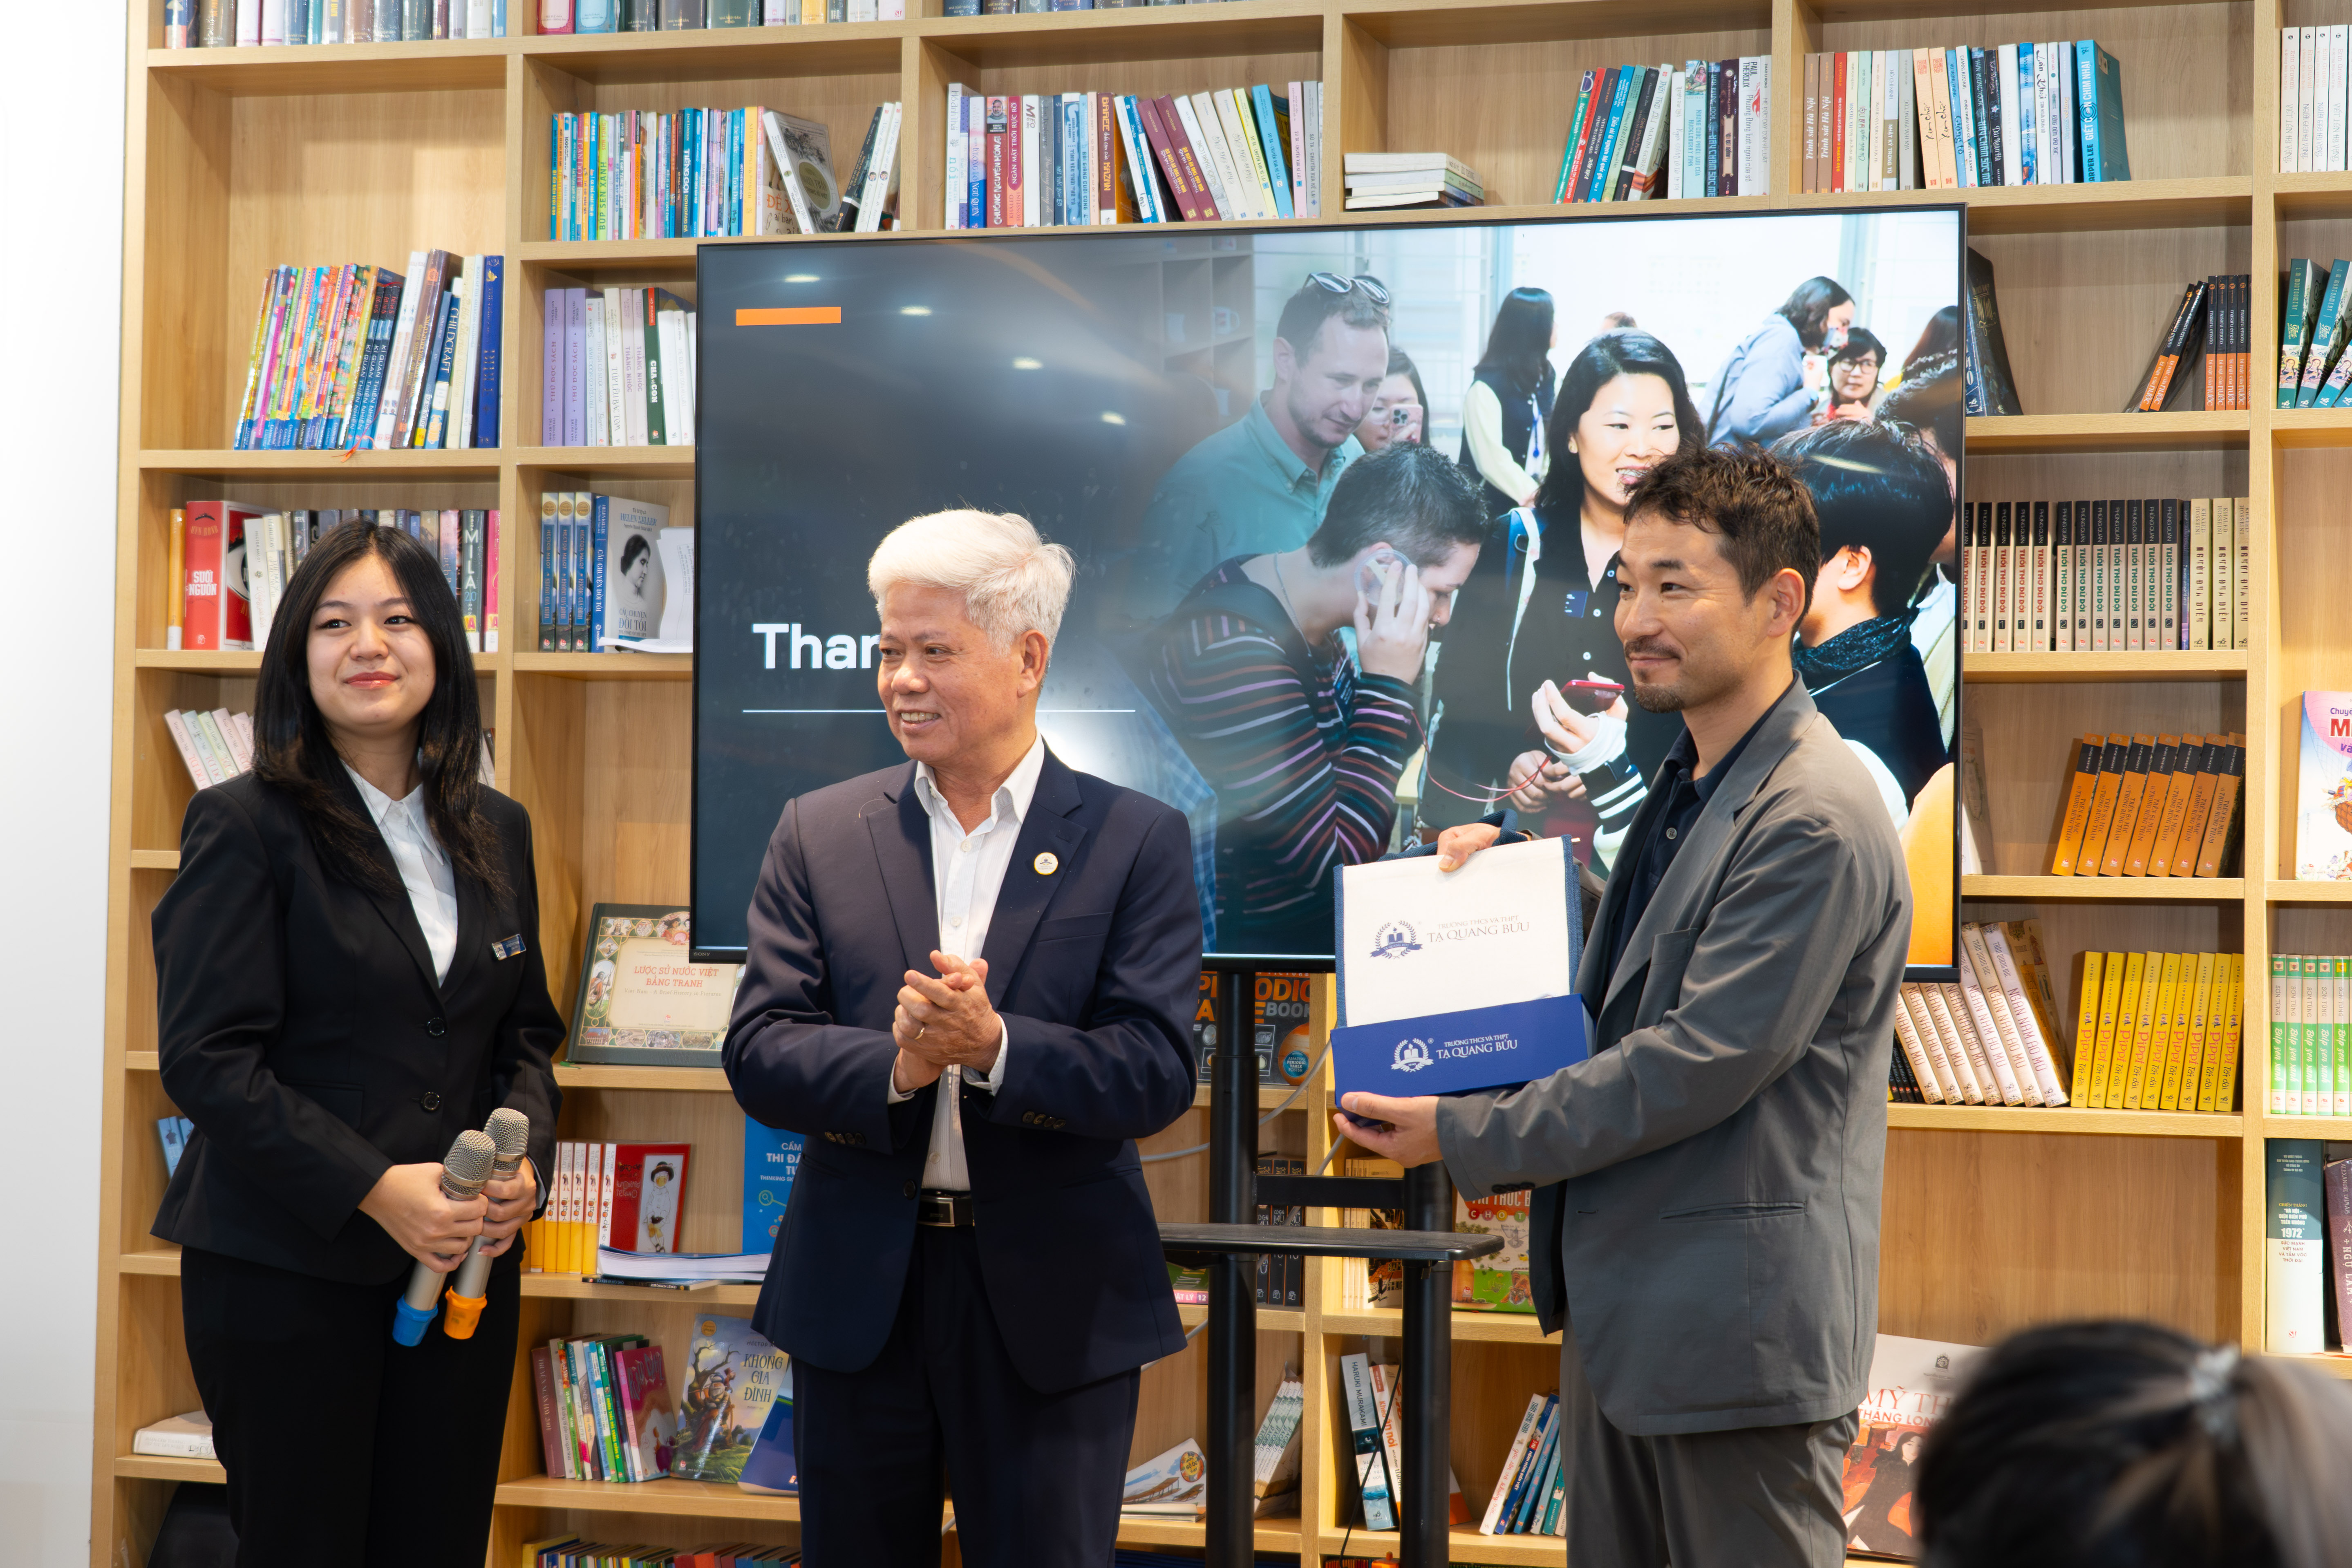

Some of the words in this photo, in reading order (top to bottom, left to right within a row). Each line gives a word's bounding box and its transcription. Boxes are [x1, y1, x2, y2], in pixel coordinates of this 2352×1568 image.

[1645, 127, 1655, 148] MAXIM
[1639, 150, 1649, 172] GORKY
[2088, 158, 2096, 182] ARPER
[441, 308, 459, 373] CHILDCRAFT
[193, 569, 214, 583] SUỐI
[1427, 932, 1444, 942] TẠ
[1447, 925, 1497, 940] QUANG
[635, 965, 657, 975] LƯỢC
[659, 964, 671, 974] SỬ
[672, 965, 696, 976] NƯỚC
[699, 967, 719, 977] VIỆT
[646, 975, 670, 986] BẰNG
[2319, 1029, 2330, 1045] Búp
[1436, 1049, 1450, 1059] TẠ
[1452, 1043, 1493, 1058] QUANG
[1496, 1039, 1517, 1051] BỬU
[2153, 1031, 2167, 1064] Pippi
[2321, 1048, 2329, 1062] sen
[2151, 1065, 2160, 1076] Tất
[2321, 1065, 2331, 1083] xanh
[2149, 1077, 2158, 1088] dài
[767, 1153, 784, 1162] THI
[2341, 1163, 2349, 1192] ALEXANDRE
[1175, 1293, 1184, 1302] ẬT
[1186, 1292, 1194, 1301] LÝ
[751, 1371, 769, 1385] GIA
[744, 1387, 772, 1403] ĐÌNH
[1352, 1362, 1360, 1387] HARUKI
[1356, 1389, 1367, 1426] MURAKAMI
